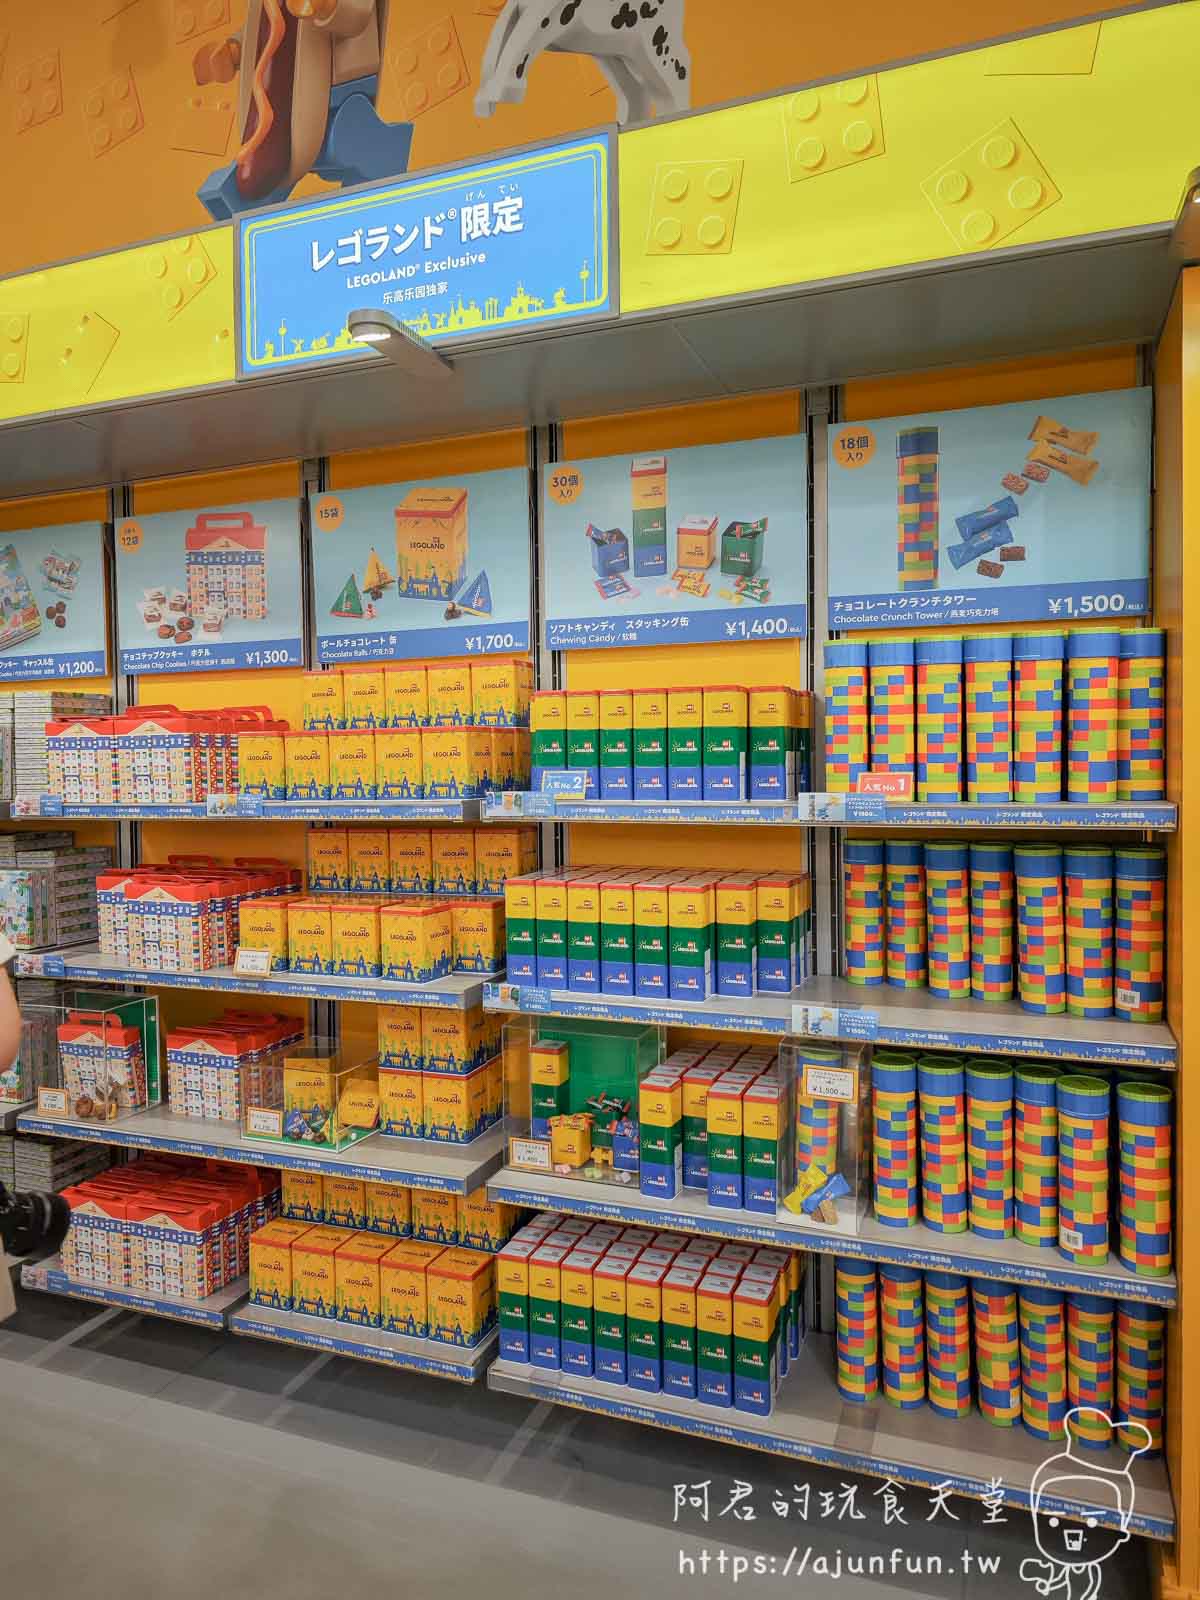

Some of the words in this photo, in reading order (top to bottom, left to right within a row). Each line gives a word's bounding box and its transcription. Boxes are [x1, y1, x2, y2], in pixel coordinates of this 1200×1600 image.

[424, 251, 487, 275] Exclusive
[382, 281, 449, 305] 乐高乐园独家
[833, 595, 977, 612] チョコレートクランチタワー
[1047, 593, 1125, 617] ¥1,500
[550, 621, 616, 634] ソフトキャンディ
[625, 616, 689, 630] スタッキング缶
[833, 612, 879, 624] Chocolate
[880, 611, 913, 622] Crunch
[915, 611, 943, 620] Tower
[725, 617, 788, 639] ¥1,400
[320, 638, 386, 650] ボールチョコレート
[465, 633, 514, 653] ¥1,700
[550, 634, 587, 645] Chewing
[588, 633, 616, 643] Candy
[245, 650, 289, 668] ¥1,300
[58, 660, 96, 677] ¥1,200
